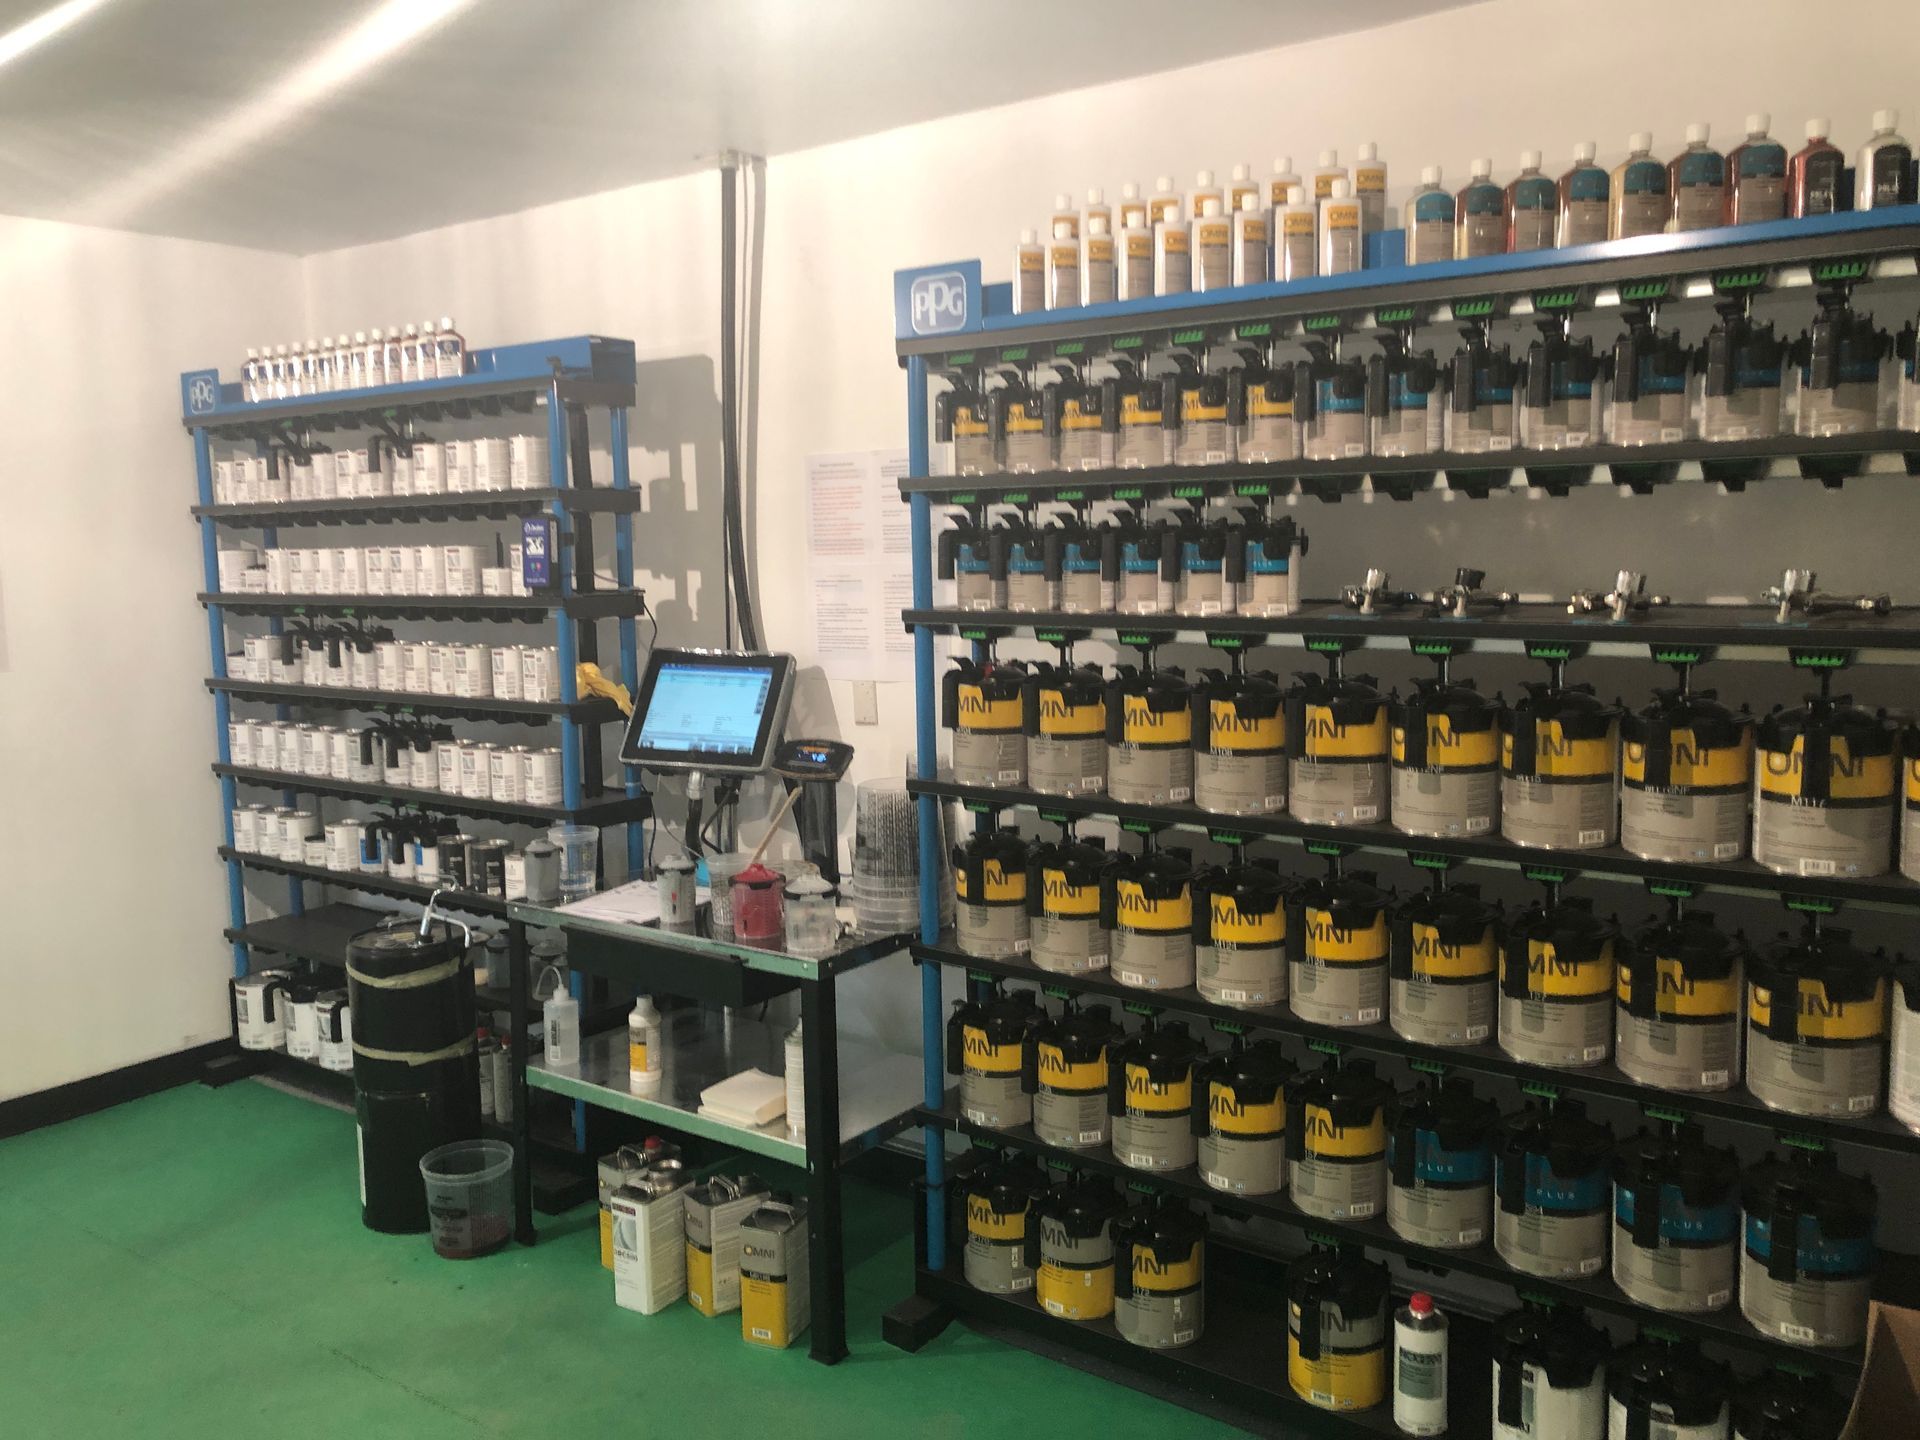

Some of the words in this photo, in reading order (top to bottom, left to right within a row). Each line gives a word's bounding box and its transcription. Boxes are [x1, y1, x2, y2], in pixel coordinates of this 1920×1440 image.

[958, 696, 992, 714] MNI
[1040, 700, 1075, 718] MNI
[1124, 708, 1164, 727] MNI
[1210, 712, 1259, 733] MNI
[1306, 718, 1346, 739] MNI
[1043, 880, 1082, 898] MNI
[1118, 891, 1158, 913] MNI
[1214, 904, 1263, 927] MNI
[1306, 920, 1352, 944] MNI
[1412, 937, 1461, 960] MNI
[1528, 953, 1578, 977] MNI
[964, 1036, 999, 1057] MNI
[1038, 1054, 1073, 1074] MNI
[1126, 1073, 1169, 1096] MNI
[1210, 1094, 1245, 1118] MNI
[1305, 1116, 1344, 1140] MNI
[969, 1203, 1006, 1226] MNI
[1041, 1225, 1079, 1249] MNI
[743, 1244, 775, 1259] OMNI
[1133, 1255, 1169, 1276] MNI
